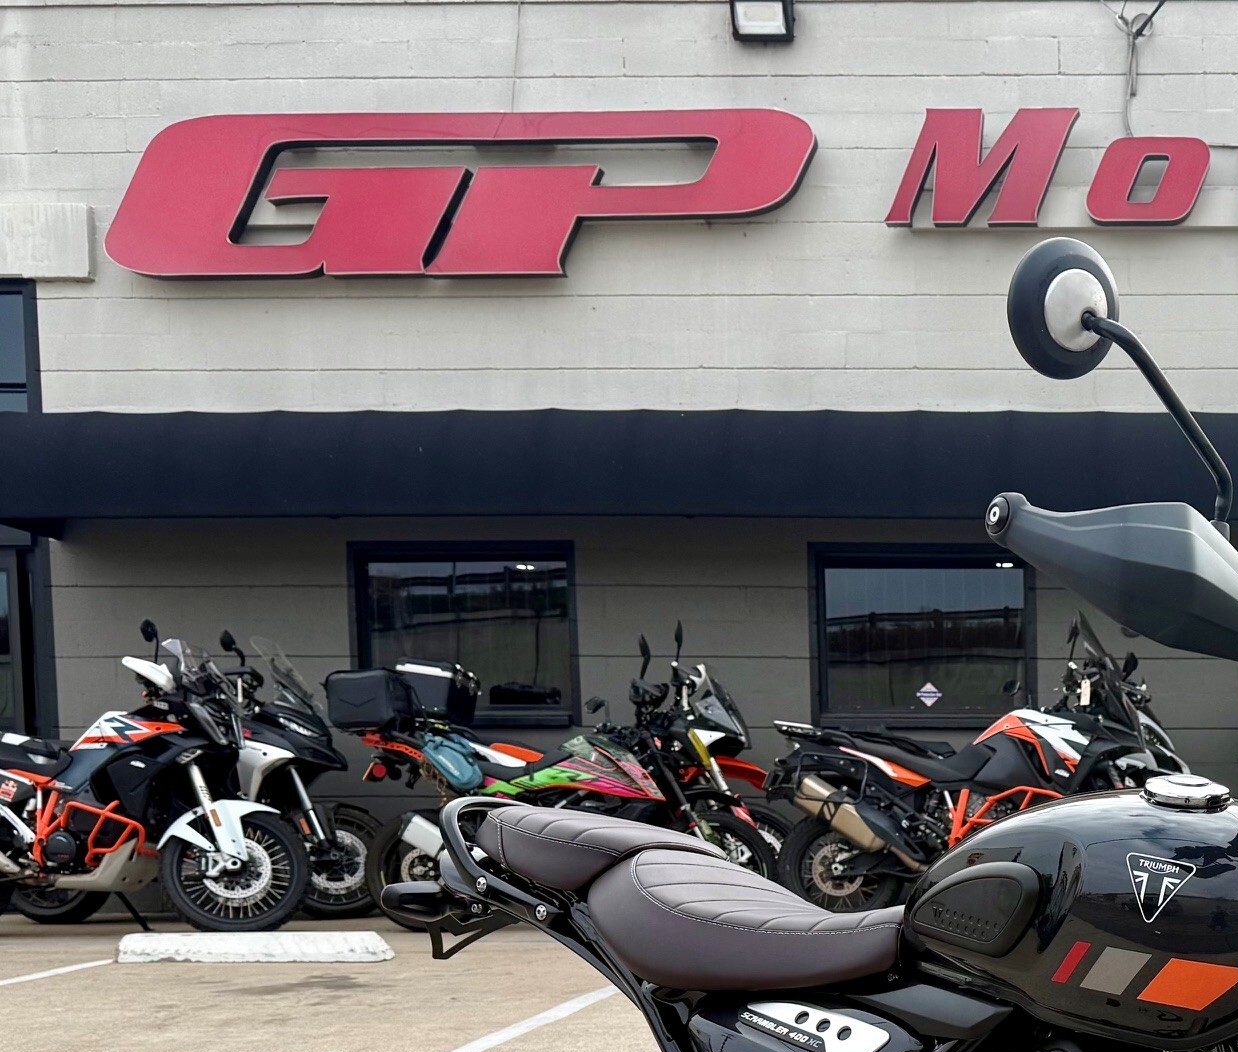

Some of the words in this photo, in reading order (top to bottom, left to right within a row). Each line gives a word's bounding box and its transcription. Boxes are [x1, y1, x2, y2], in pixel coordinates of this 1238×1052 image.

[105, 108, 818, 279] GP
[1139, 858, 1180, 874] TRIUMPH
[740, 1011, 790, 1036] SCRAMBLER
[788, 1032, 809, 1044] 400
[806, 1037, 823, 1048] XC
